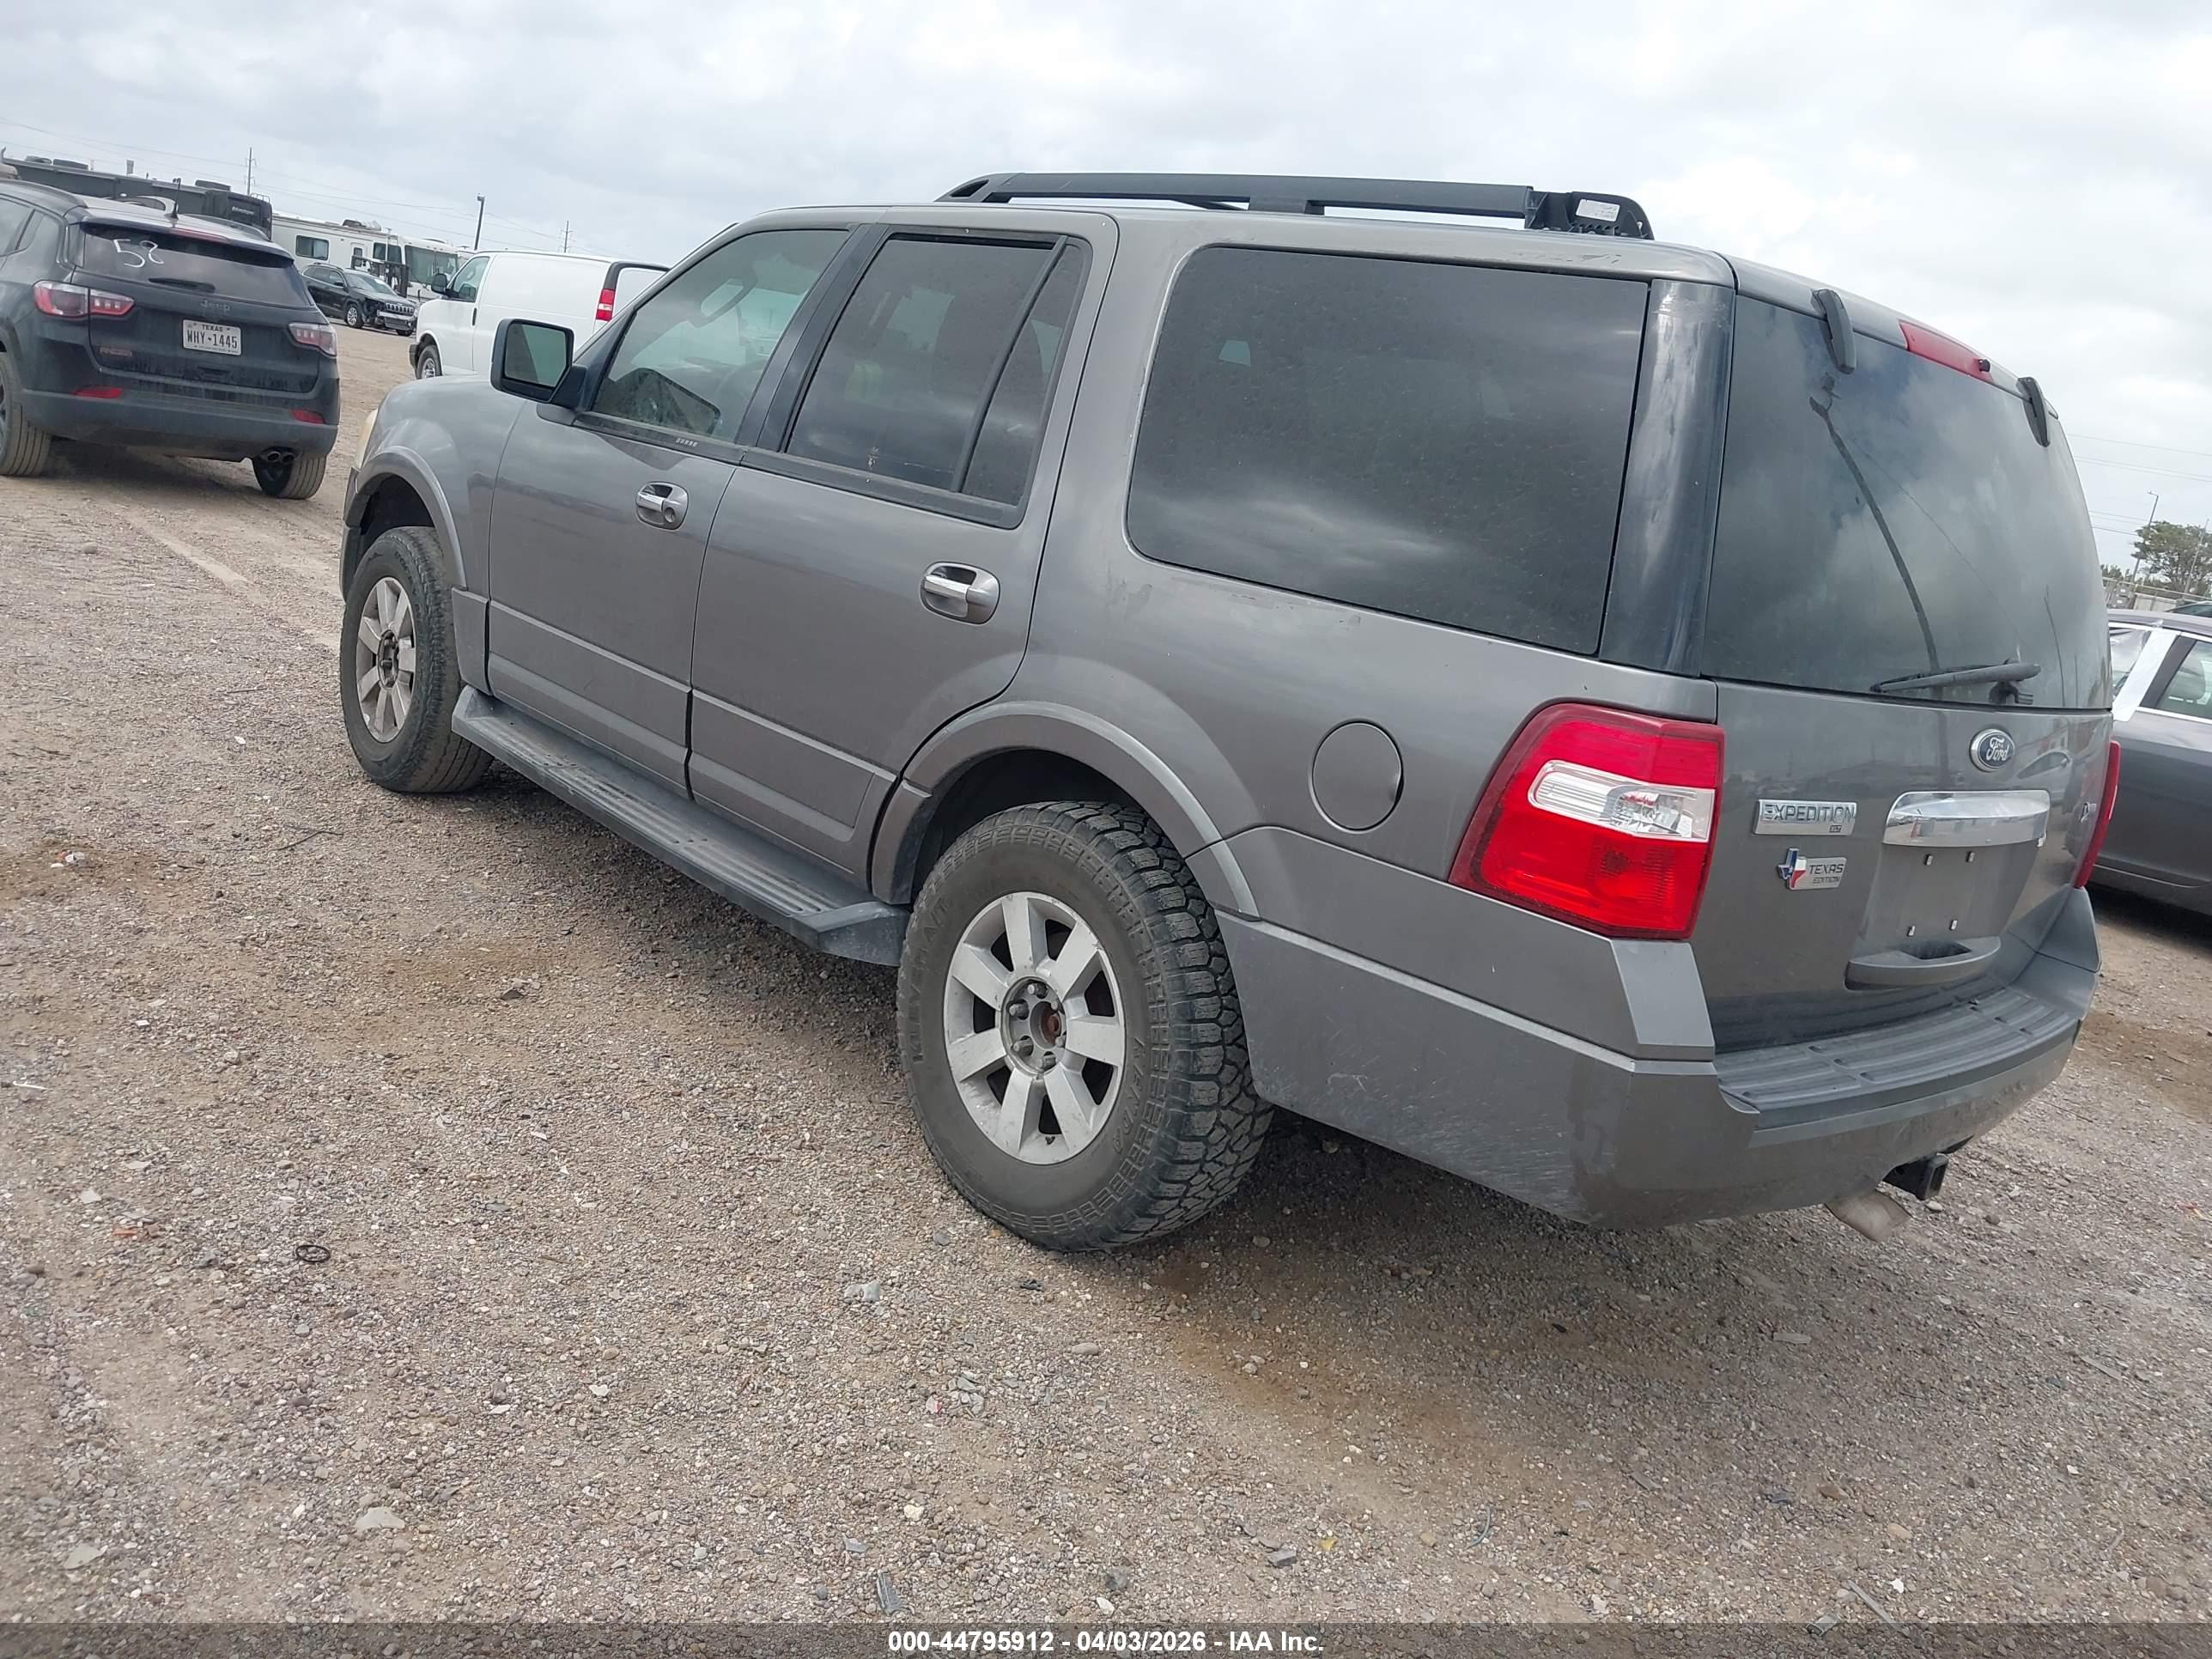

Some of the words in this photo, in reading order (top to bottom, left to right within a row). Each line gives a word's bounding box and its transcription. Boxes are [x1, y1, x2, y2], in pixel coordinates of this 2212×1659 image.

[202, 324, 223, 332] TEXAS
[1985, 737, 2010, 761] Ford
[1764, 803, 1856, 823] EXPEDITION
[1809, 863, 1844, 875] TEXAS
[1812, 876, 1842, 884] EDITION
